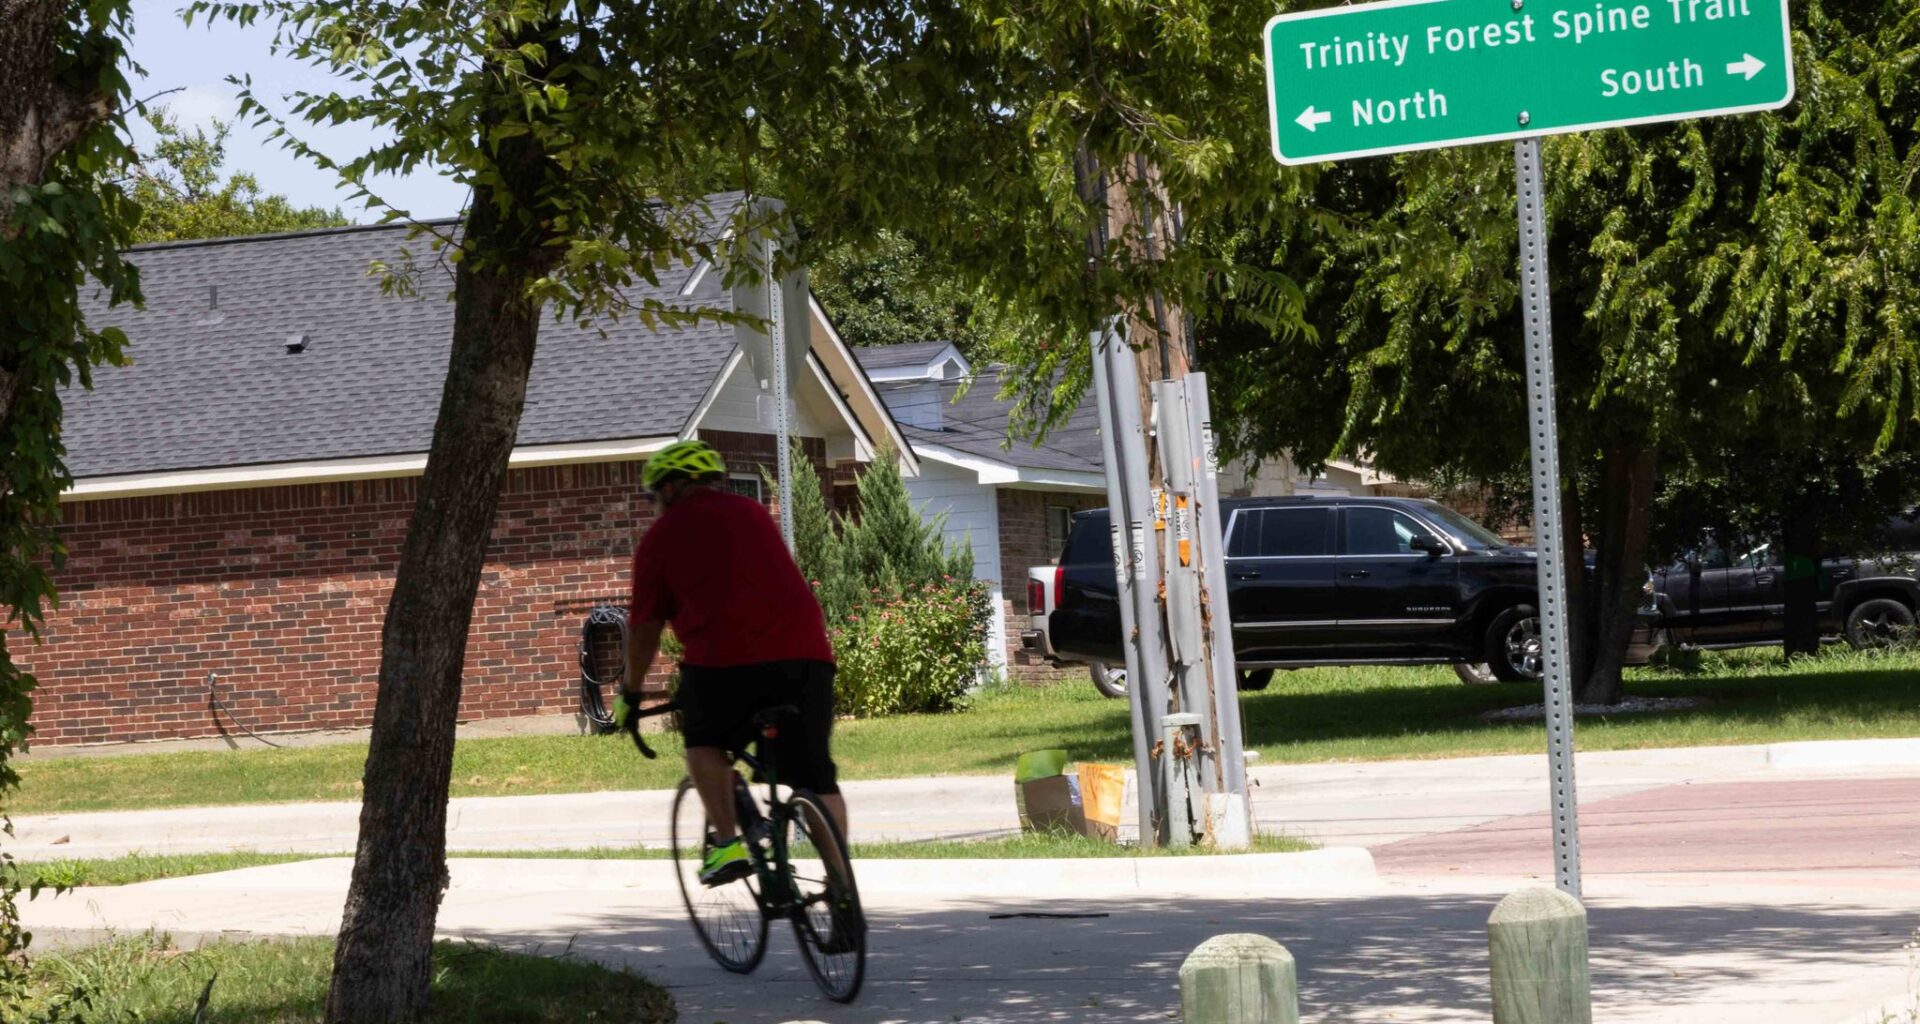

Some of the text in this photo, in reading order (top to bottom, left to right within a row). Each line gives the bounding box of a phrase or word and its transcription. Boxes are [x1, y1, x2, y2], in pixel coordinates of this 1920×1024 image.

[1300, 0, 1751, 70] Trinity Forest Spine Trail
[1600, 58, 1703, 97] South
[1352, 88, 1448, 127] North
